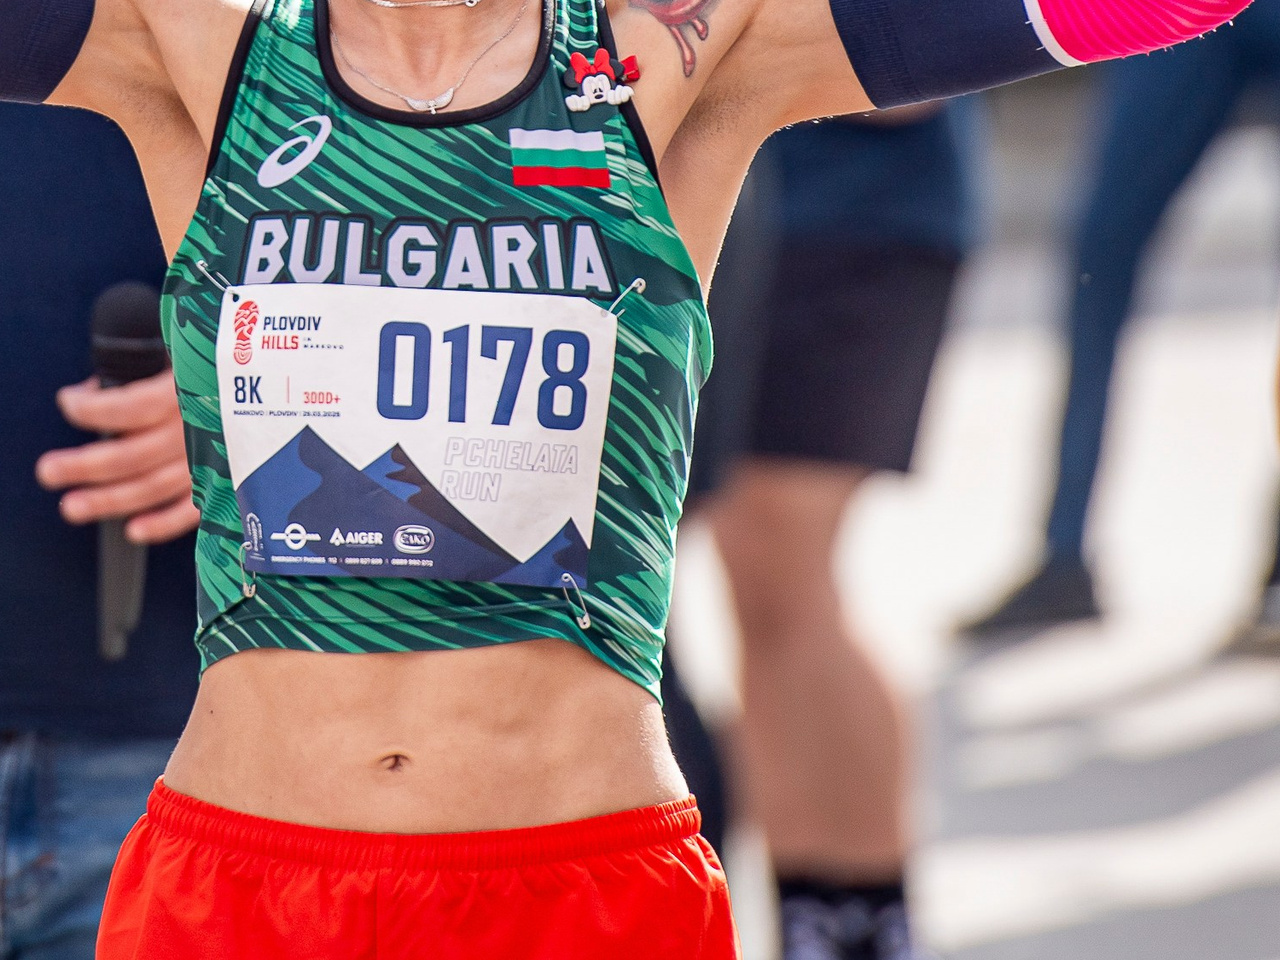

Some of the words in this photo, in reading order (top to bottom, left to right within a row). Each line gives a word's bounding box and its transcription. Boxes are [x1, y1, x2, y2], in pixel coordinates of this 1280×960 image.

[244, 216, 613, 295] BULGARIA
[262, 315, 322, 331] PLOVDIV
[261, 335, 300, 350] HILLS
[233, 375, 264, 404] 8K
[376, 320, 591, 431] 0178
[443, 436, 579, 475] PCHELATA
[439, 469, 502, 502] RUN
[345, 531, 384, 545] AIGER
